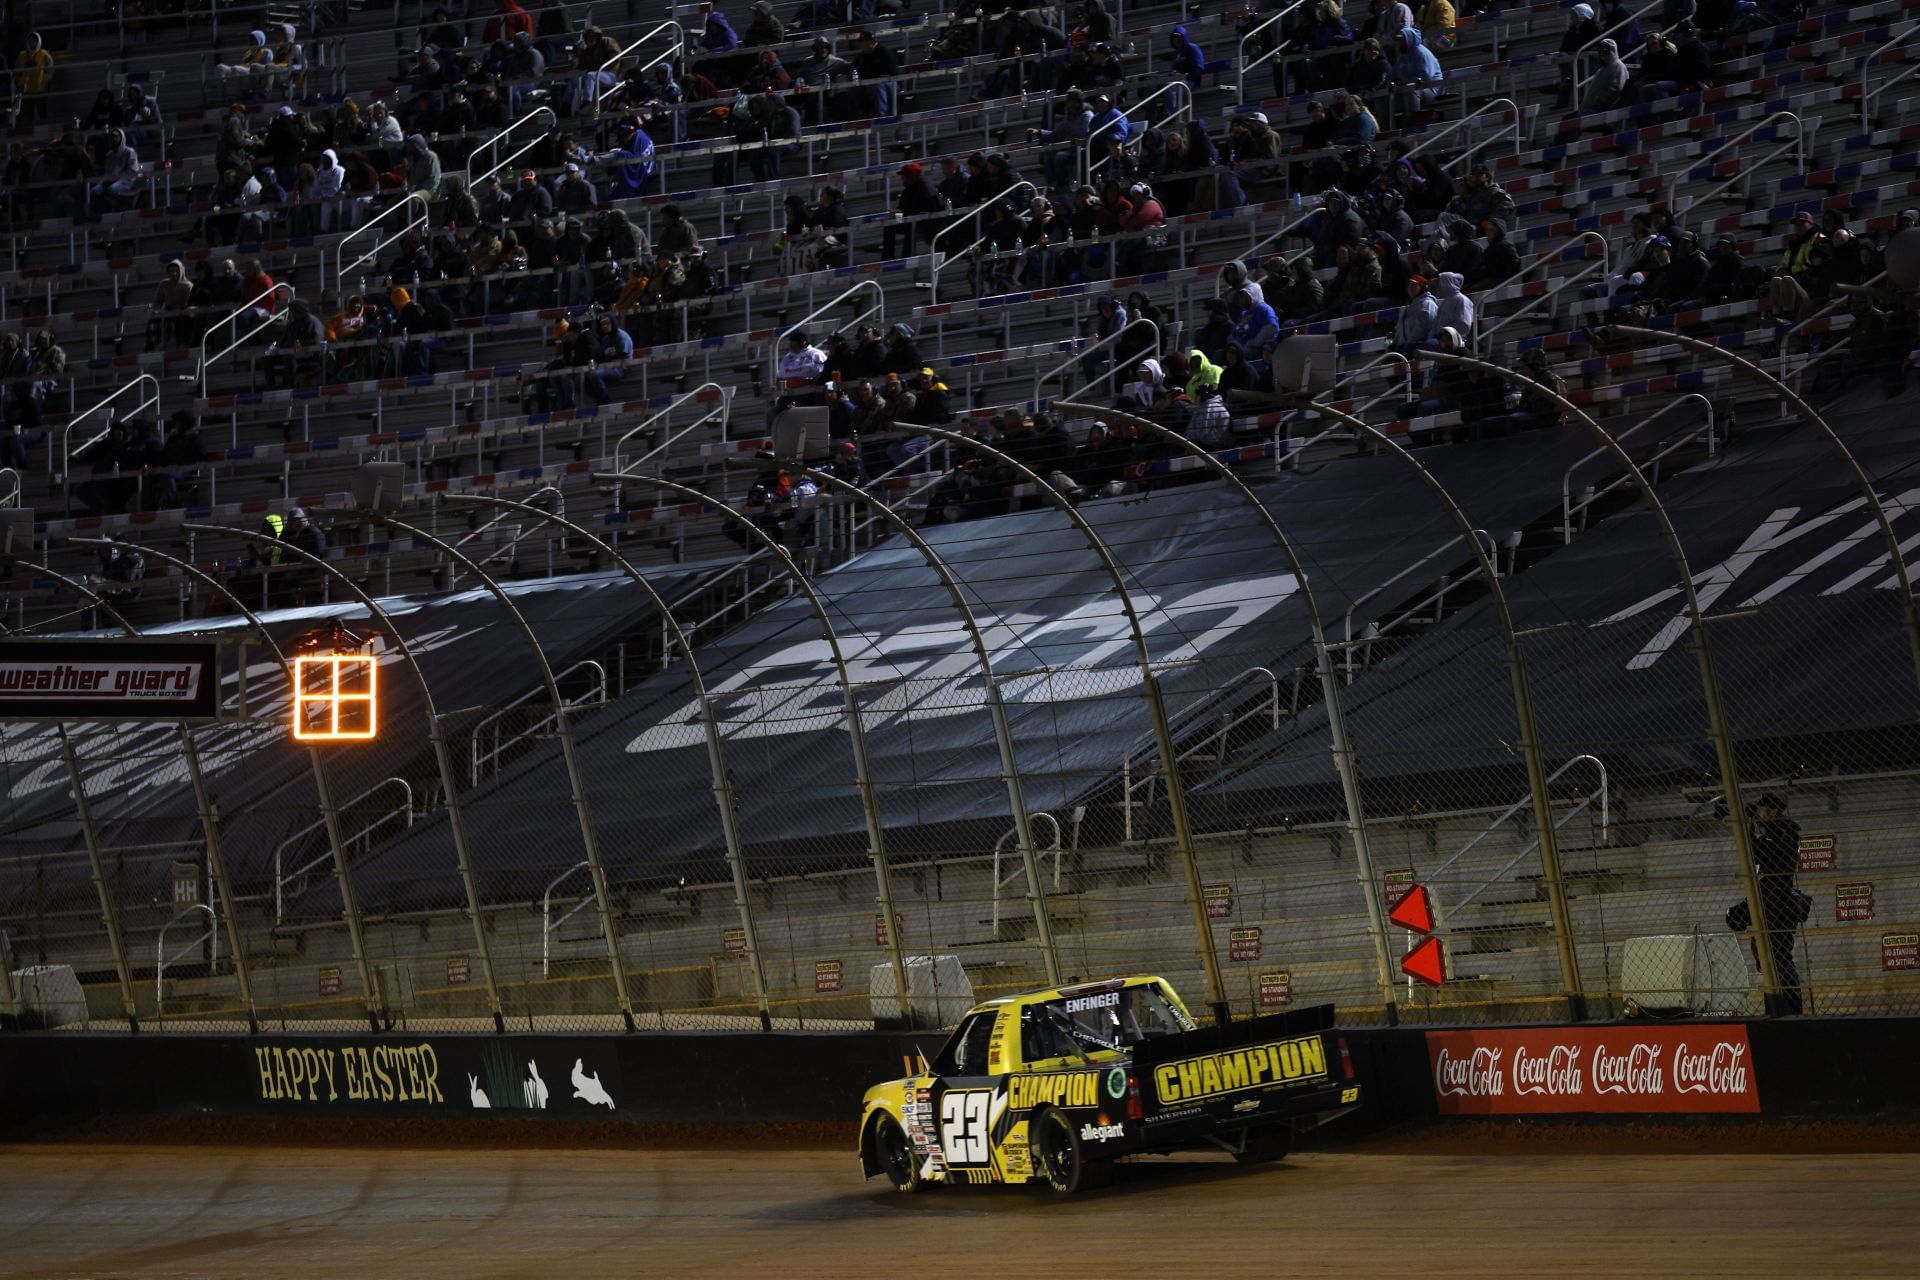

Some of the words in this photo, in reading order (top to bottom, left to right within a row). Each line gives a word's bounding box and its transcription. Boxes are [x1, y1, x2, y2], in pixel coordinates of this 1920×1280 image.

[0, 666, 109, 690] weather
[115, 666, 191, 695] guard
[1066, 993, 1120, 1013] ENFINGER
[1073, 1030, 1128, 1053] CHEVROLET
[255, 1046, 338, 1101] HAPPY
[341, 1043, 443, 1104] EASTER
[1157, 1038, 1324, 1102] CHAMPION
[1436, 1047, 1504, 1096] Coca-Cola
[1513, 1045, 1583, 1095] Coca-Cola
[1592, 1043, 1664, 1095] Coca-Cola
[1673, 1042, 1747, 1094] Coca-Cola
[1010, 1073, 1098, 1108] CHAMPION
[1341, 1087, 1359, 1103] 23
[942, 1092, 990, 1163] 23
[1080, 1122, 1124, 1143] allegiant
[1145, 1107, 1202, 1123] SILVERADO
